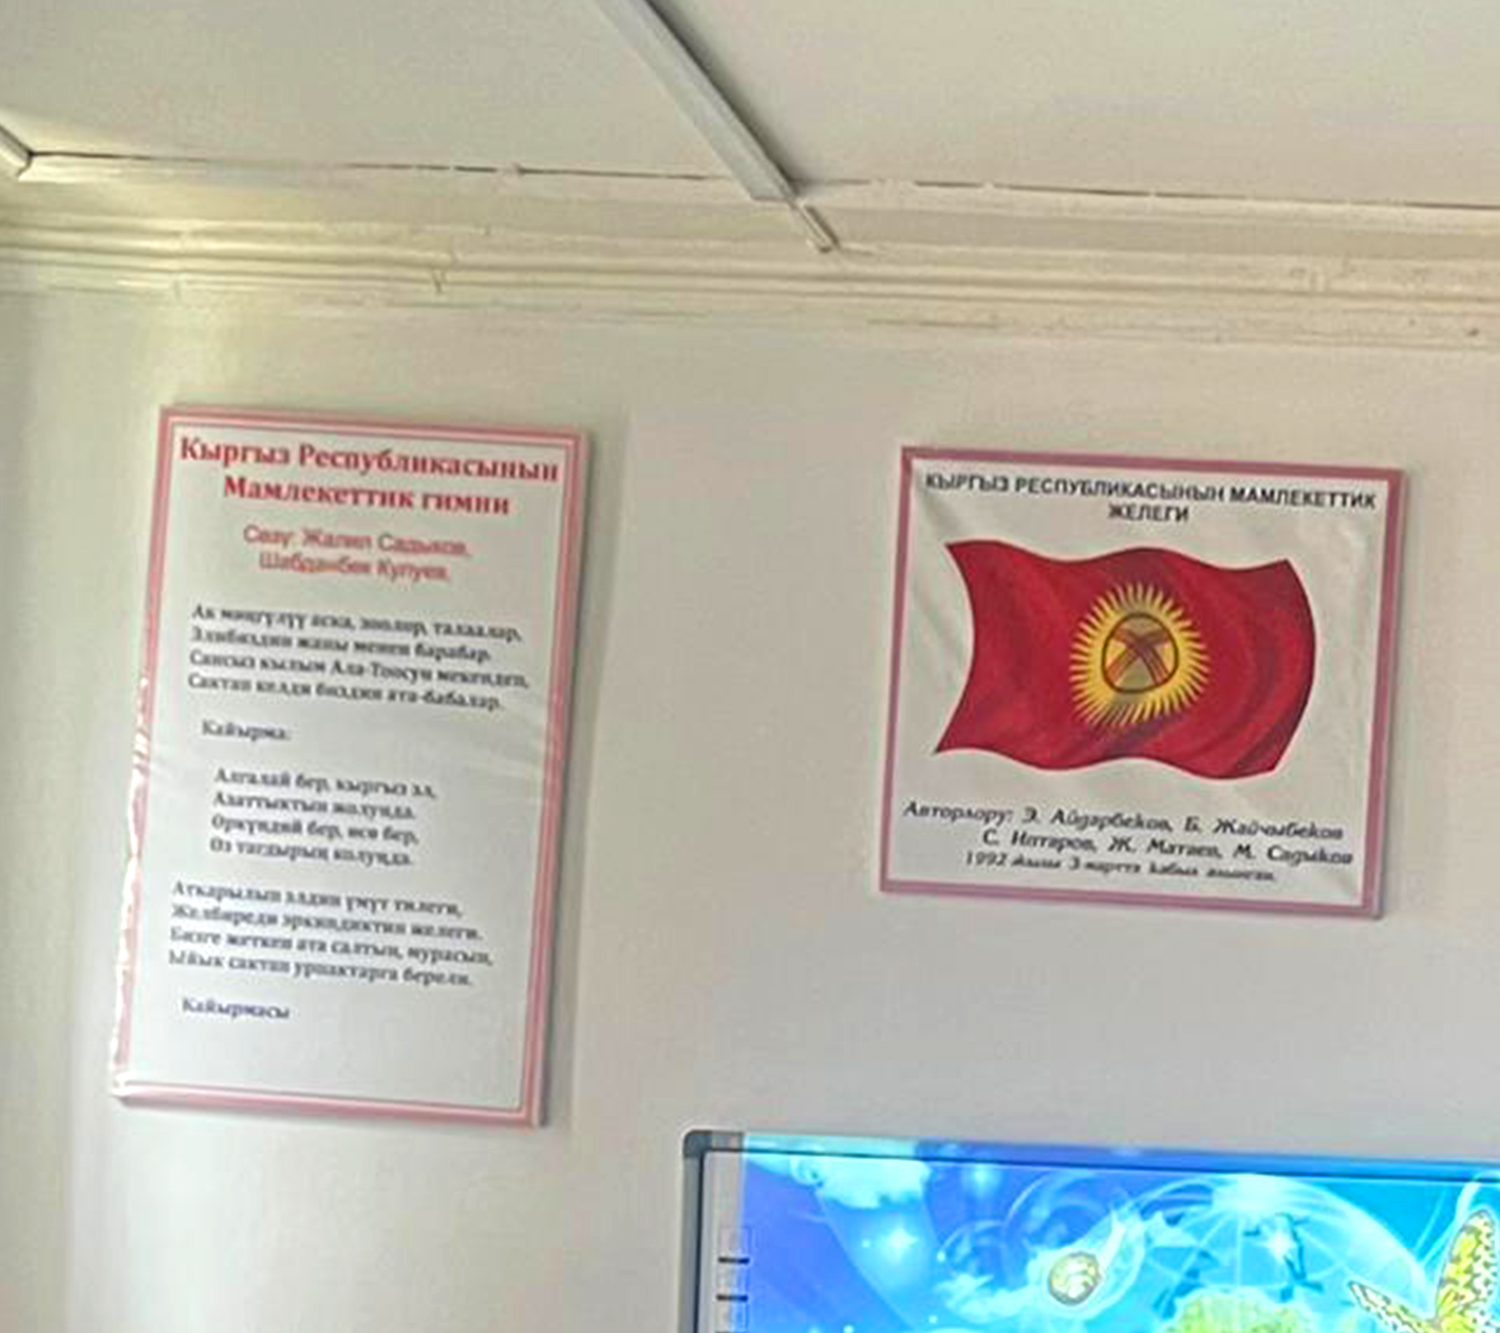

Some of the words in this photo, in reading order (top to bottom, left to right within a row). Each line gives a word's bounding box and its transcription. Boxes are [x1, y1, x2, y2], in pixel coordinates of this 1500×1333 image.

[180, 437, 292, 468] Кыргыз
[298, 444, 559, 482] Республикасынын
[223, 475, 414, 509] Мамлекеттик
[421, 488, 510, 515] гимни
[925, 475, 1009, 492] КЫРГЫЗ
[1015, 478, 1226, 502] РЕСПУБЛИКАСЫНЫН
[1230, 489, 1377, 510] МАМЛЕКЕТТИК
[1107, 504, 1190, 523] ЖЕЛЕГИ
